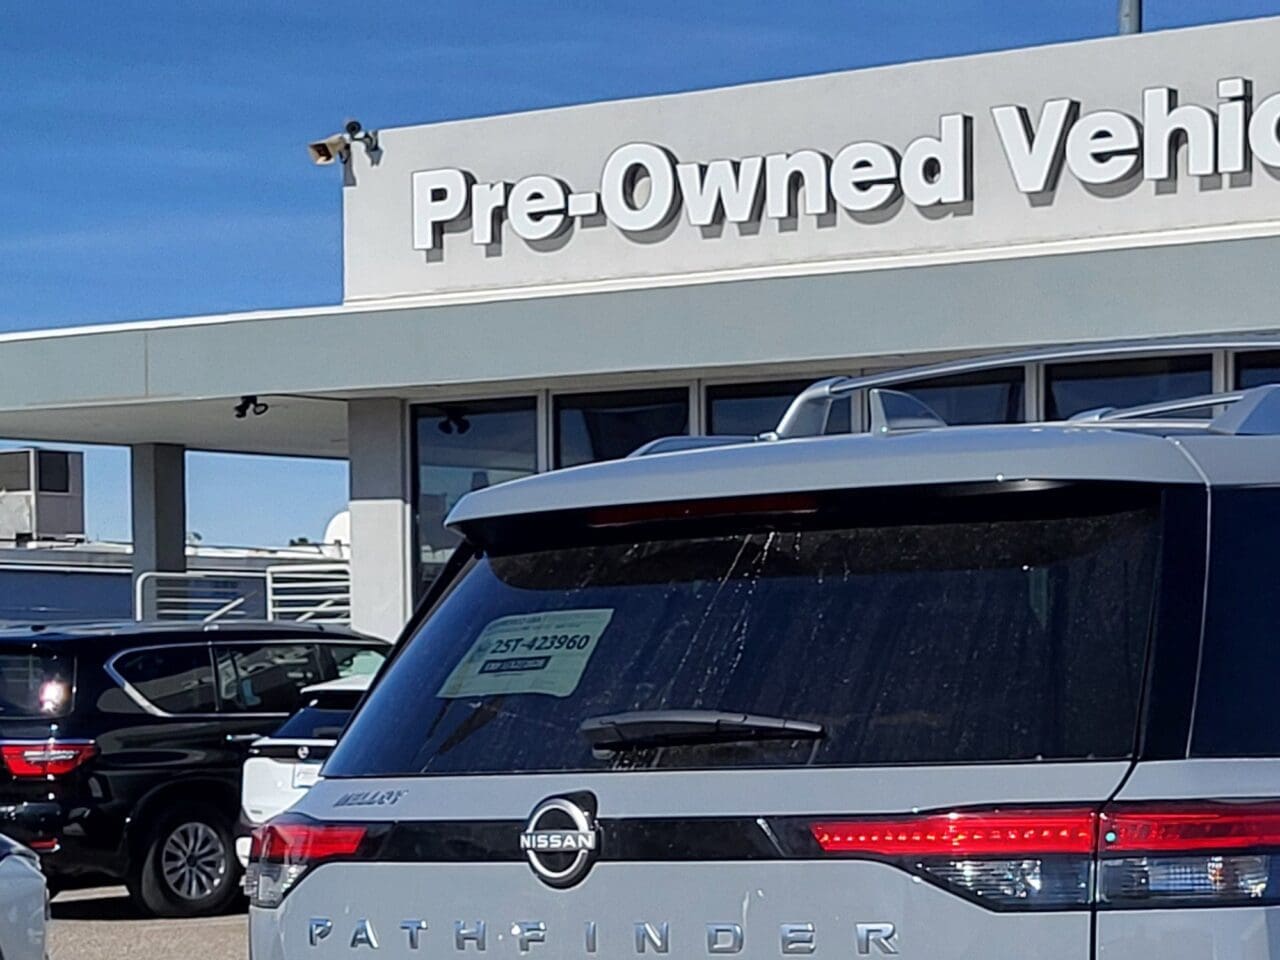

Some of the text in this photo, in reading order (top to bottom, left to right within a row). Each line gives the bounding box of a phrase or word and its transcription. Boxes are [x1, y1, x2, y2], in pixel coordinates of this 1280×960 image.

[412, 112, 973, 252] Pre-Owned
[490, 634, 591, 654] 25T-423960
[520, 833, 595, 850] NISSAN
[308, 919, 899, 954] PATHFINDER
